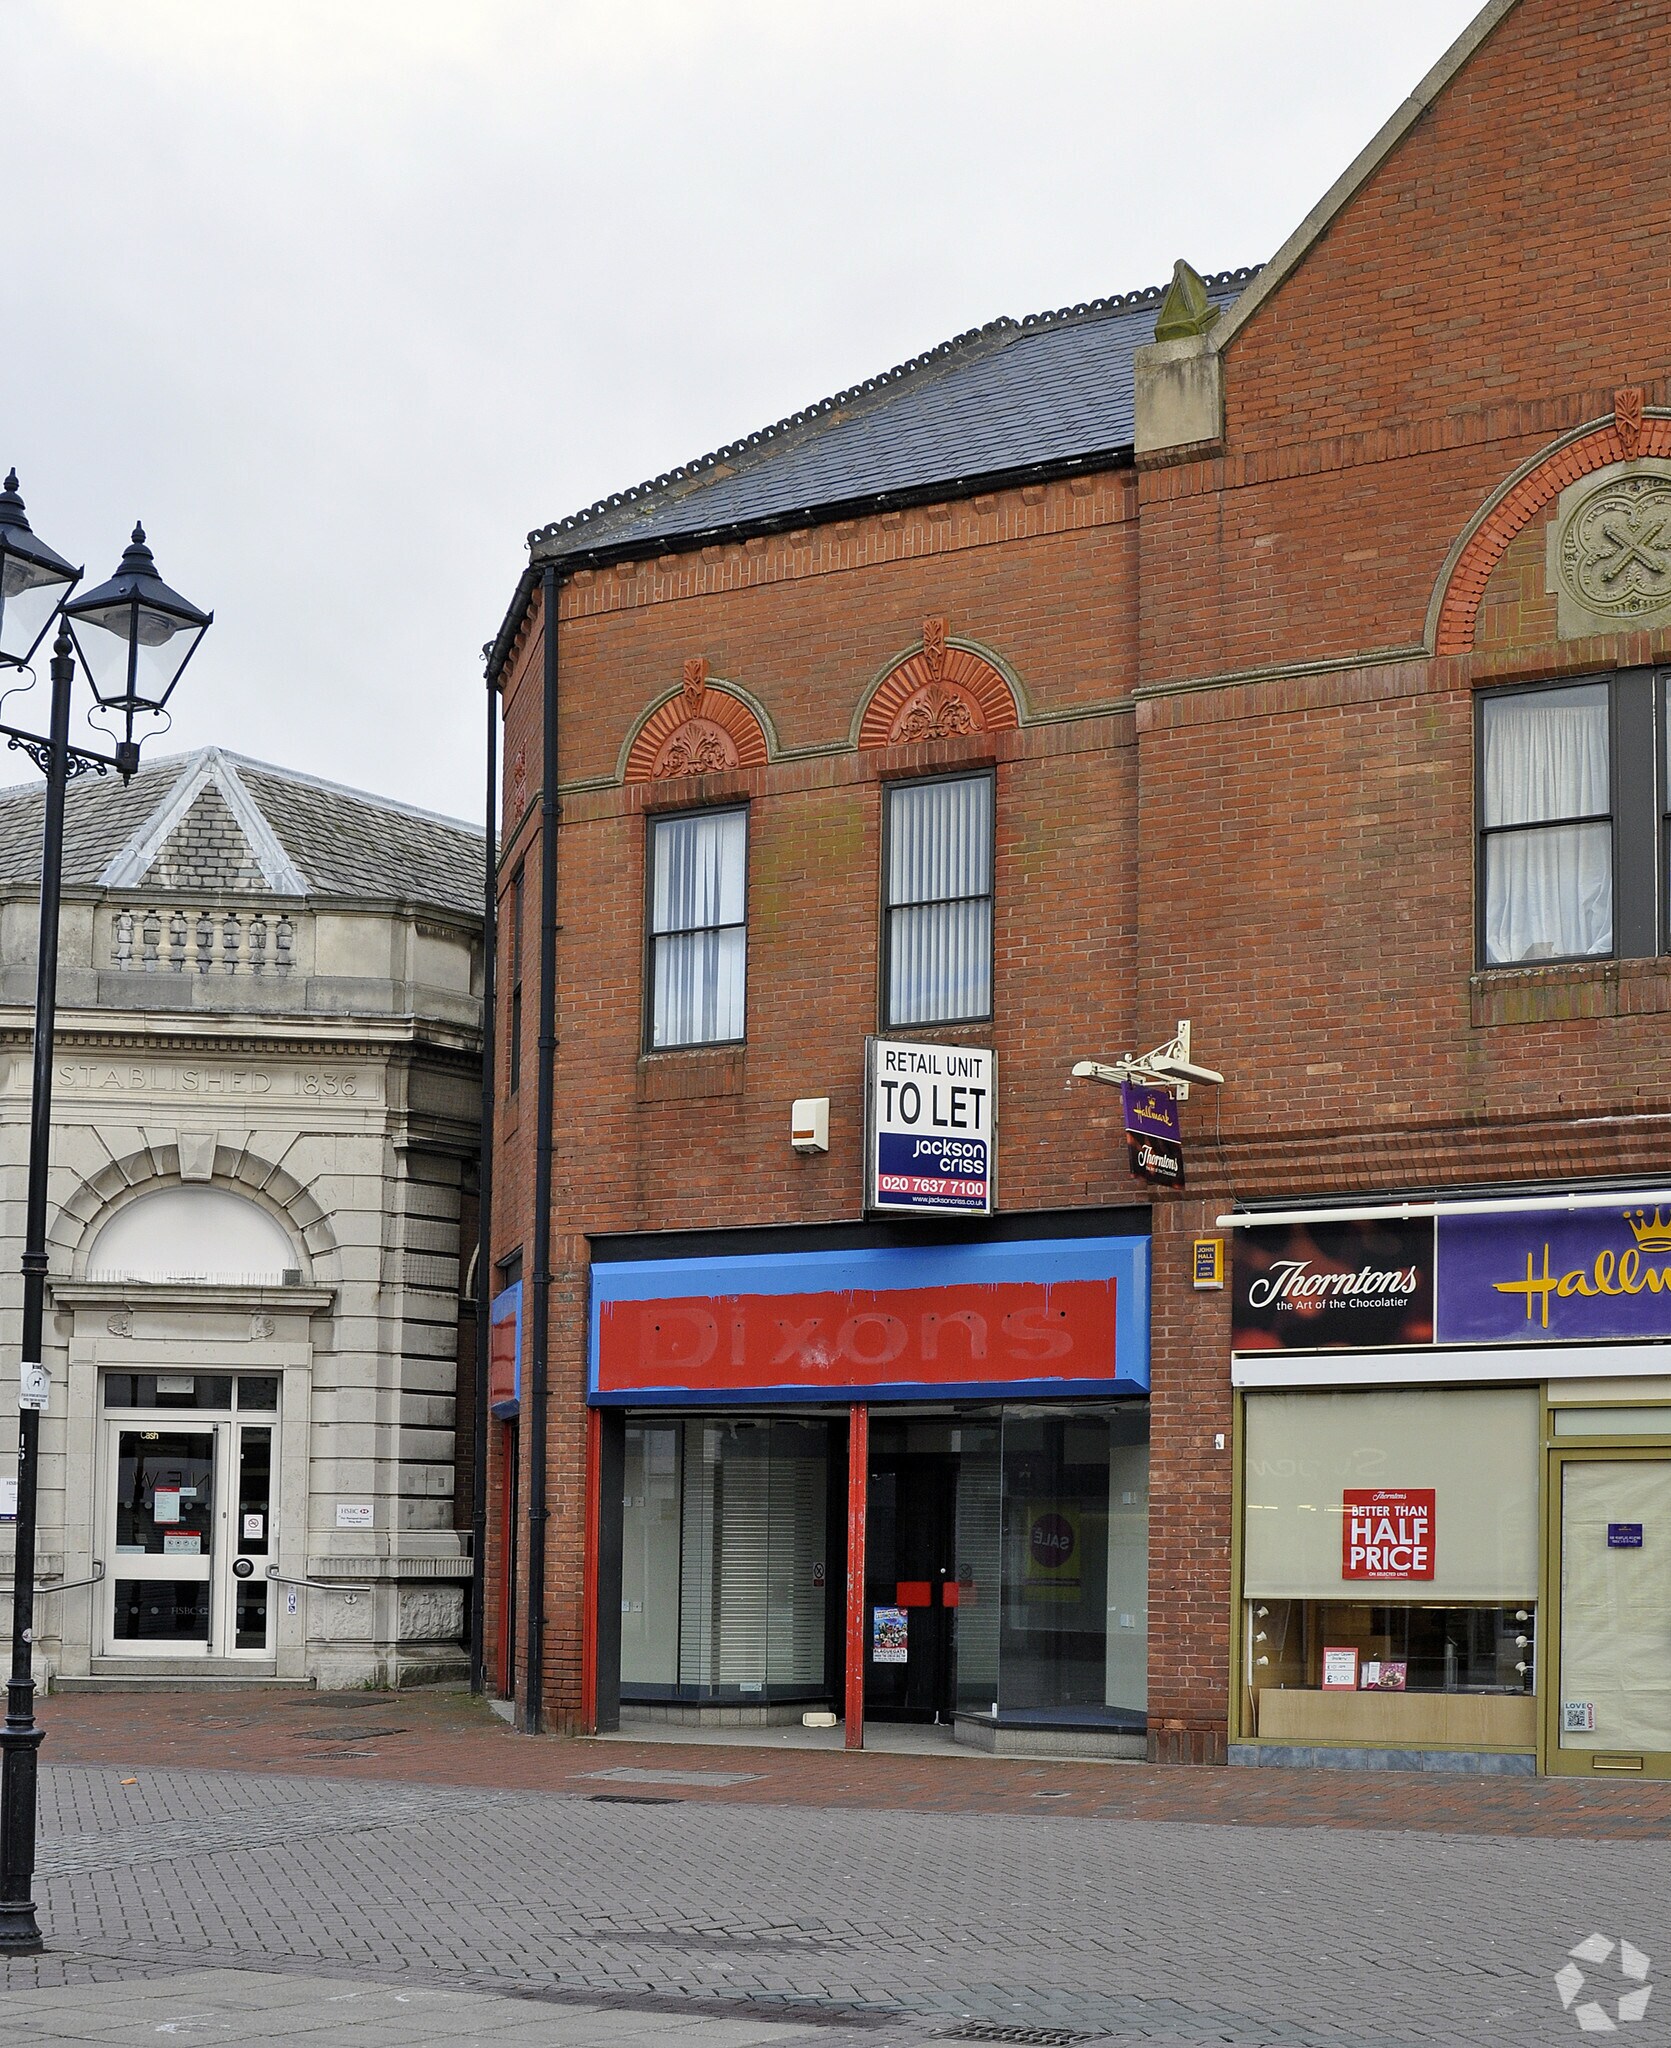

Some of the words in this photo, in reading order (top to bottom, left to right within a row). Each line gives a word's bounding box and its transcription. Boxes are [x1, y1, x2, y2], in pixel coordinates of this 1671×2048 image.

[885, 1051, 942, 1075] RETAIL
[946, 1055, 982, 1078] UNIT
[58, 1066, 272, 1093] STABLISHED
[295, 1072, 357, 1096] 1836
[880, 1080, 921, 1124] TO
[932, 1085, 986, 1129] LET
[1133, 1101, 1173, 1127] Hallmark
[912, 1139, 984, 1158] jackson
[1138, 1145, 1178, 1171] Thorntons
[939, 1158, 984, 1174] criss
[882, 1176, 908, 1191] 020
[913, 1178, 946, 1193] 7637
[951, 1181, 983, 1195] 7100
[912, 1195, 983, 1206] www.jacksoncriss.co.uk
[1248, 1260, 1417, 1308] Thorntons
[1277, 1301, 1293, 1310] the
[1296, 1301, 1312, 1310] Art
[1315, 1300, 1326, 1309] of
[1329, 1299, 1346, 1309] the
[1349, 1297, 1408, 1308] Chocolatier
[639, 1306, 1075, 1367] Dixons
[1372, 1491, 1406, 1501] Thorntons
[1351, 1506, 1390, 1516] BETTER
[1394, 1505, 1428, 1516] THAN
[1351, 1518, 1428, 1545] HALF
[1350, 1546, 1428, 1570] PRICE
[171, 1606, 196, 1615] HSBC
